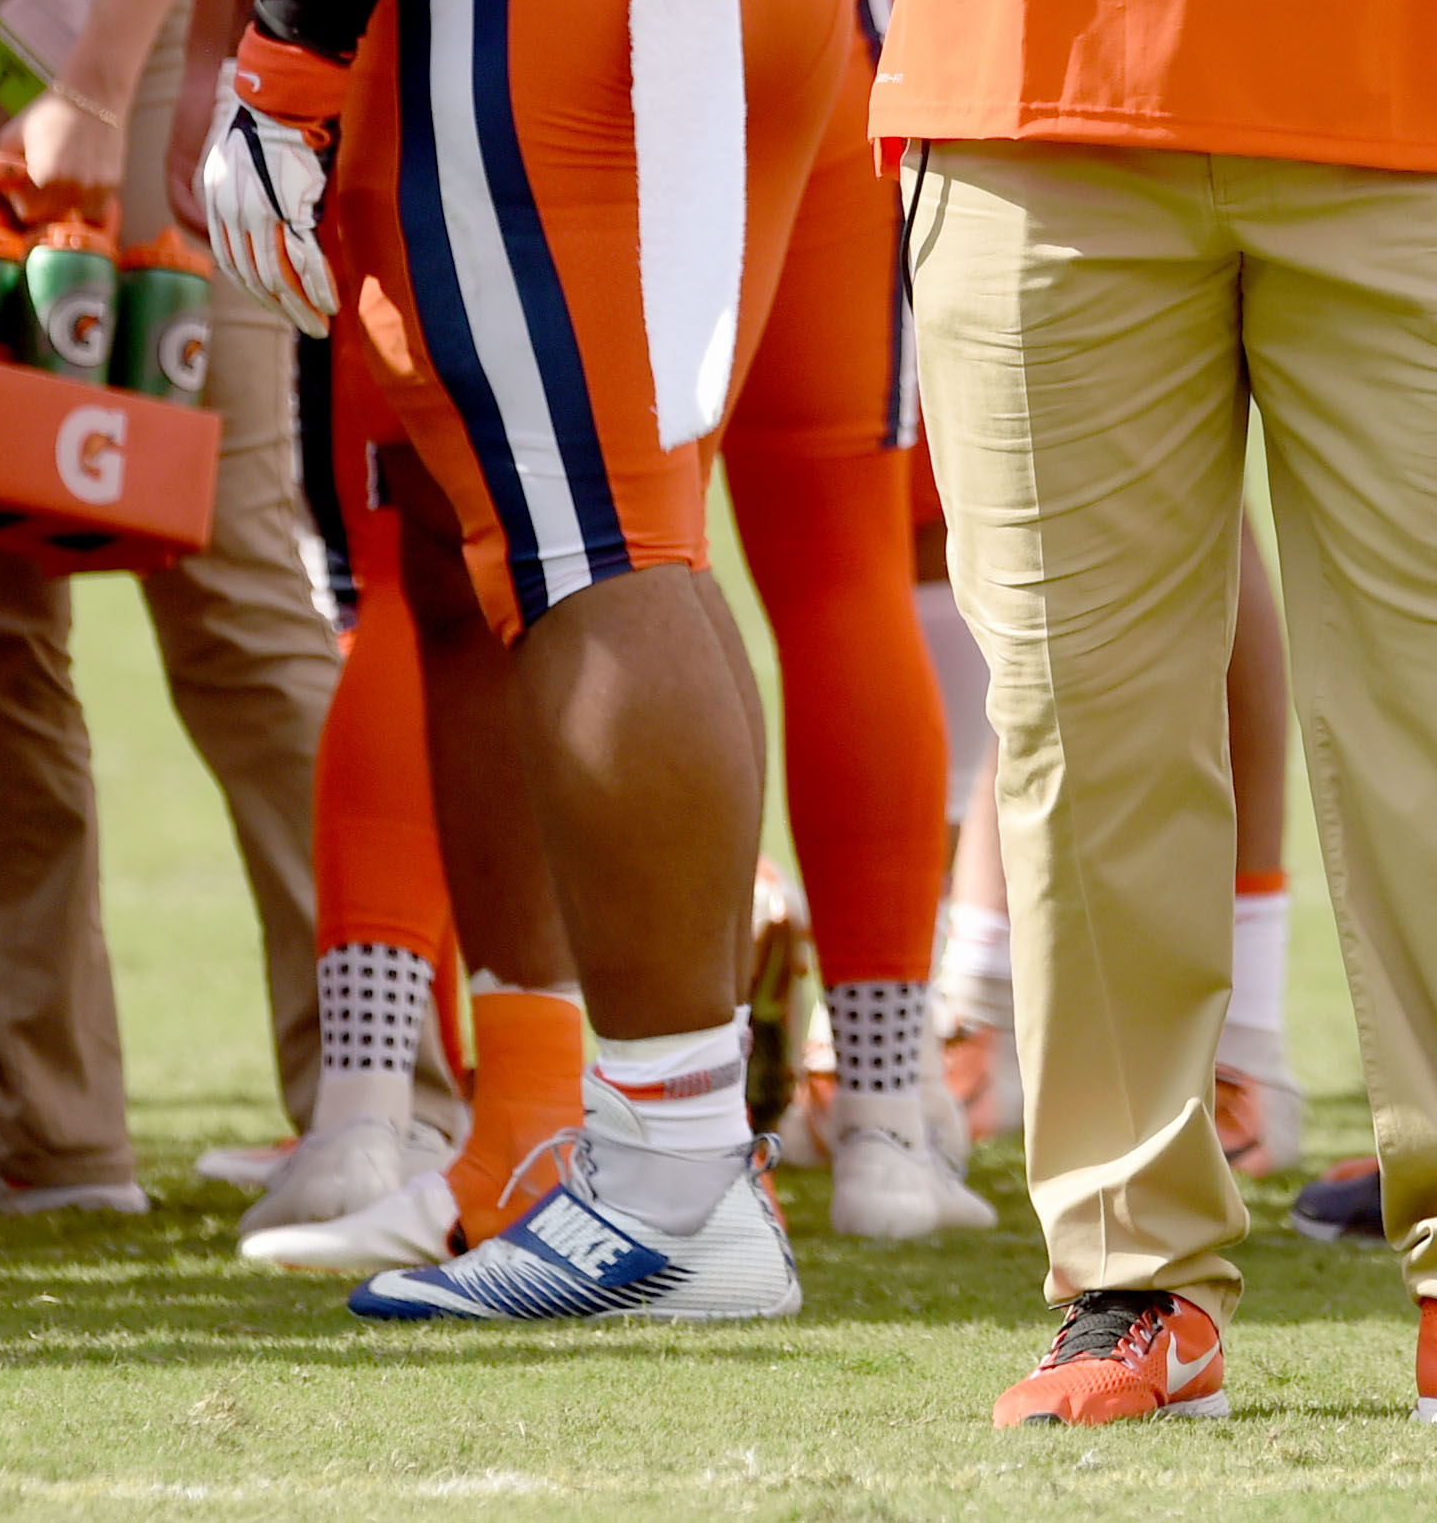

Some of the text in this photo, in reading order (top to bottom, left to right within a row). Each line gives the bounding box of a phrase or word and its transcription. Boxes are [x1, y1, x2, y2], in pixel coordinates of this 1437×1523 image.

[49, 299, 105, 368] G
[159, 324, 210, 392] G
[55, 404, 127, 506] G
[526, 1193, 634, 1280] NIKE
